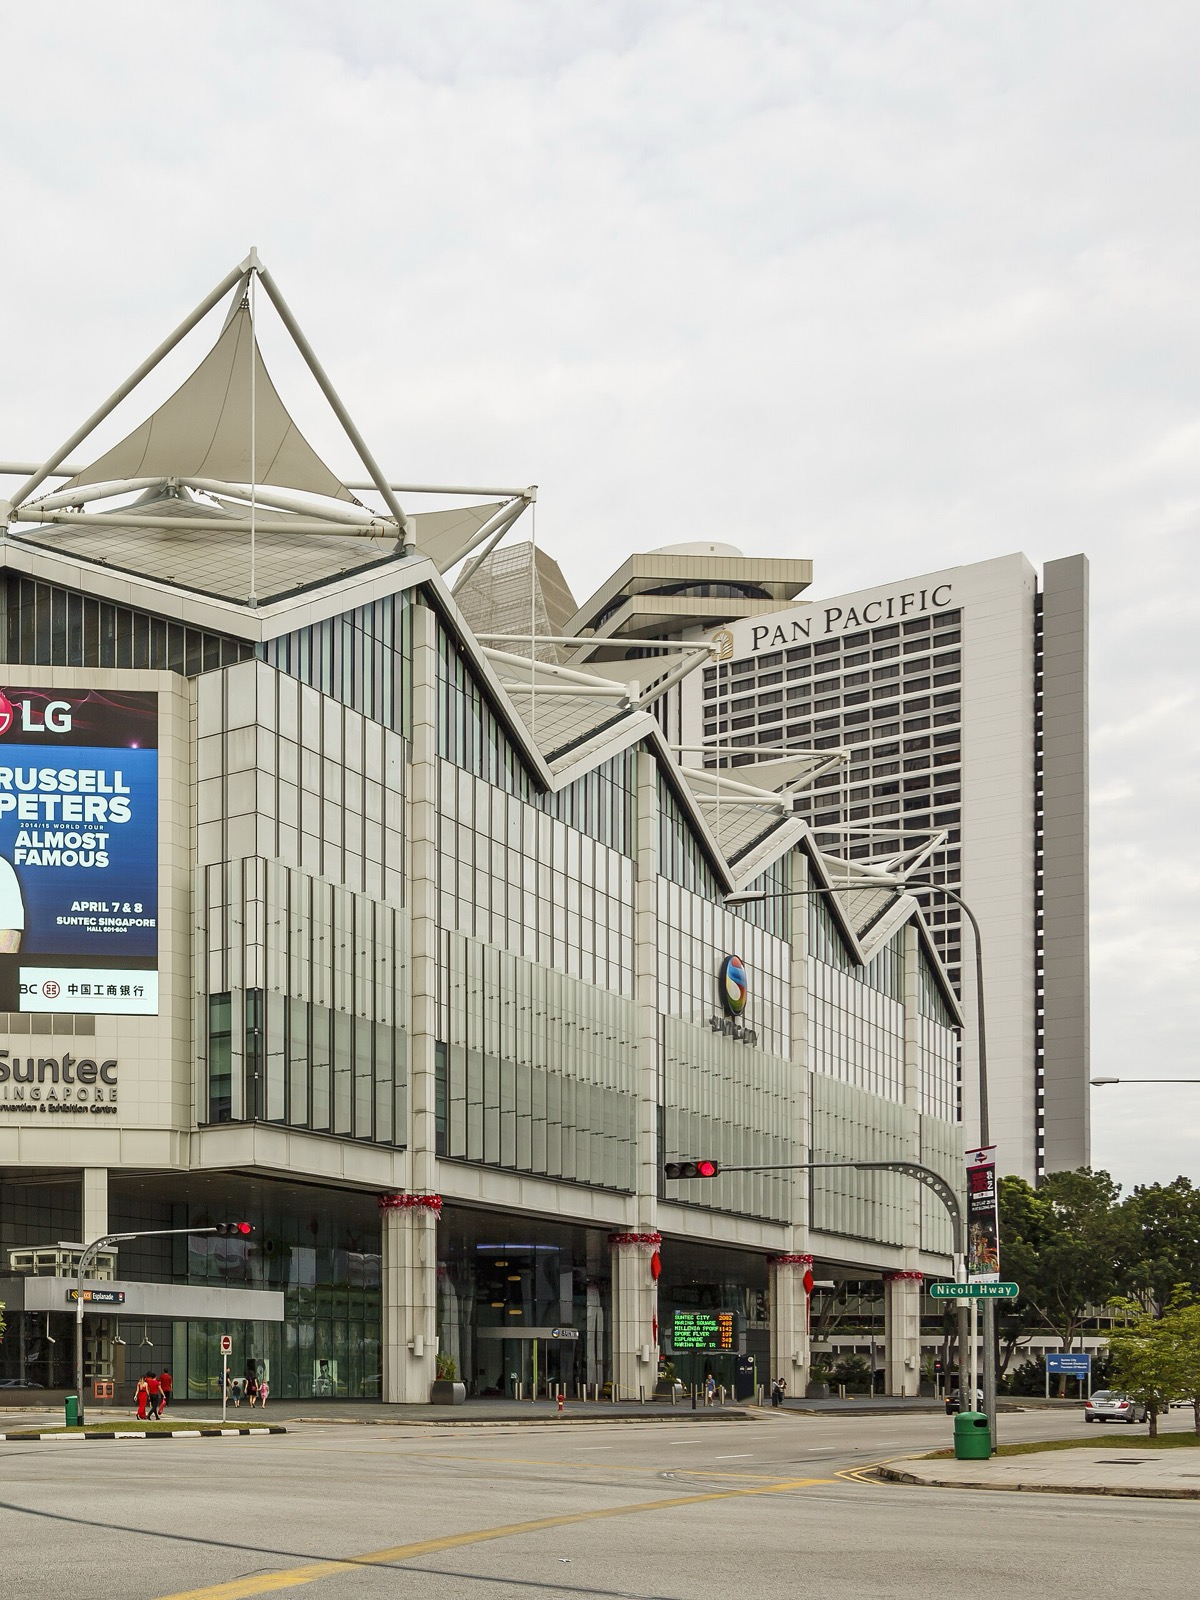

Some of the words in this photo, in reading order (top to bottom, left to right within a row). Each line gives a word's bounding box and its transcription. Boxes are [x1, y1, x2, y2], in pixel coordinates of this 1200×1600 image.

[751, 617, 812, 651] PAN
[823, 584, 952, 634] PACIFIC
[22, 700, 72, 733] LG
[14, 830, 110, 850] ALMOST
[14, 848, 110, 868] FAMOUS
[70, 901, 110, 913] APRIL
[111, 902, 120, 913] 7
[122, 902, 132, 913] &
[133, 902, 143, 914] 8
[56, 916, 97, 926] SUNTEC
[98, 917, 156, 927] SINGAPORE
[68, 983, 144, 997] 中国工商银行
[39, 1103, 47, 1113] &
[47, 1103, 89, 1113] Exhibition
[89, 1104, 118, 1114] Centre
[92, 1292, 114, 1301] Esplanade
[936, 1285, 973, 1295] Nicoll
[979, 1285, 1012, 1296] Hway
